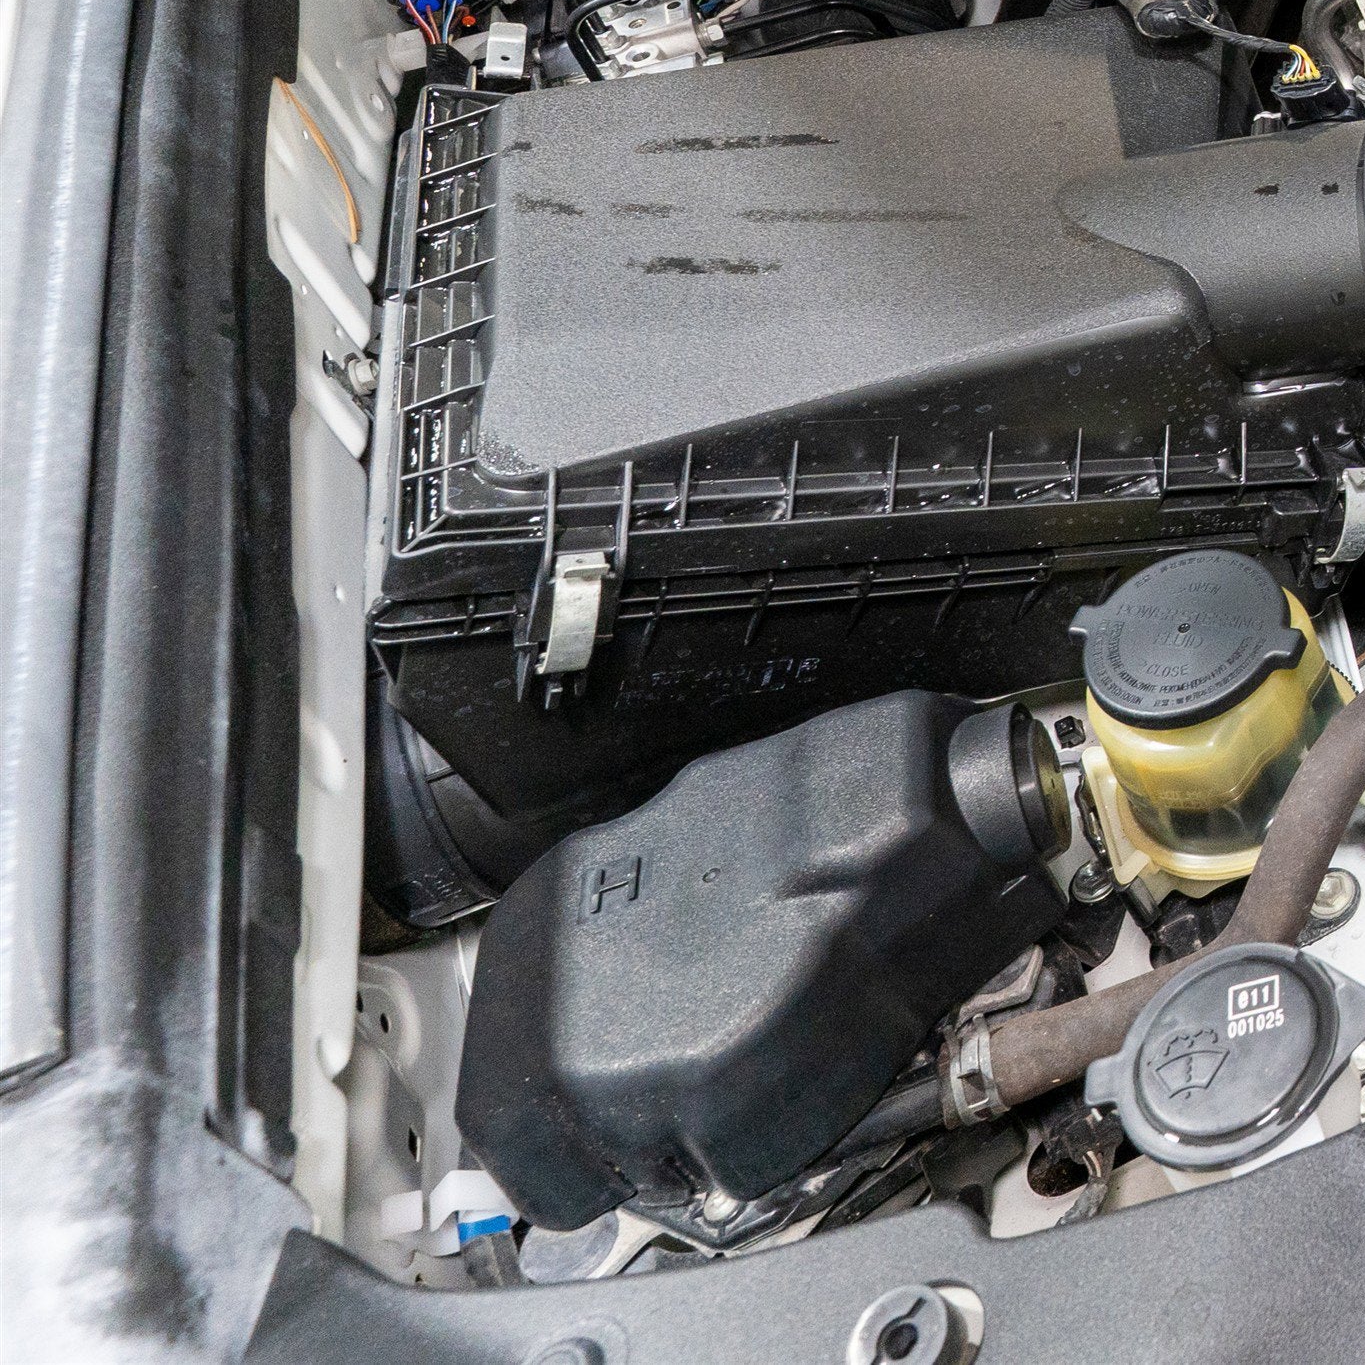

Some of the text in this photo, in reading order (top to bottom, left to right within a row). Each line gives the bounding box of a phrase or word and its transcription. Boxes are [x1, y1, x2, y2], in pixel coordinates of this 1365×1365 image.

[1189, 582, 1221, 595] OPEN
[1117, 603, 1265, 631] POWER STEERING
[1153, 633, 1204, 648] FLUID
[1147, 663, 1189, 678] CLOSE
[589, 854, 642, 915] H
[1237, 984, 1270, 1010] e11
[1227, 1008, 1285, 1039] 001025
